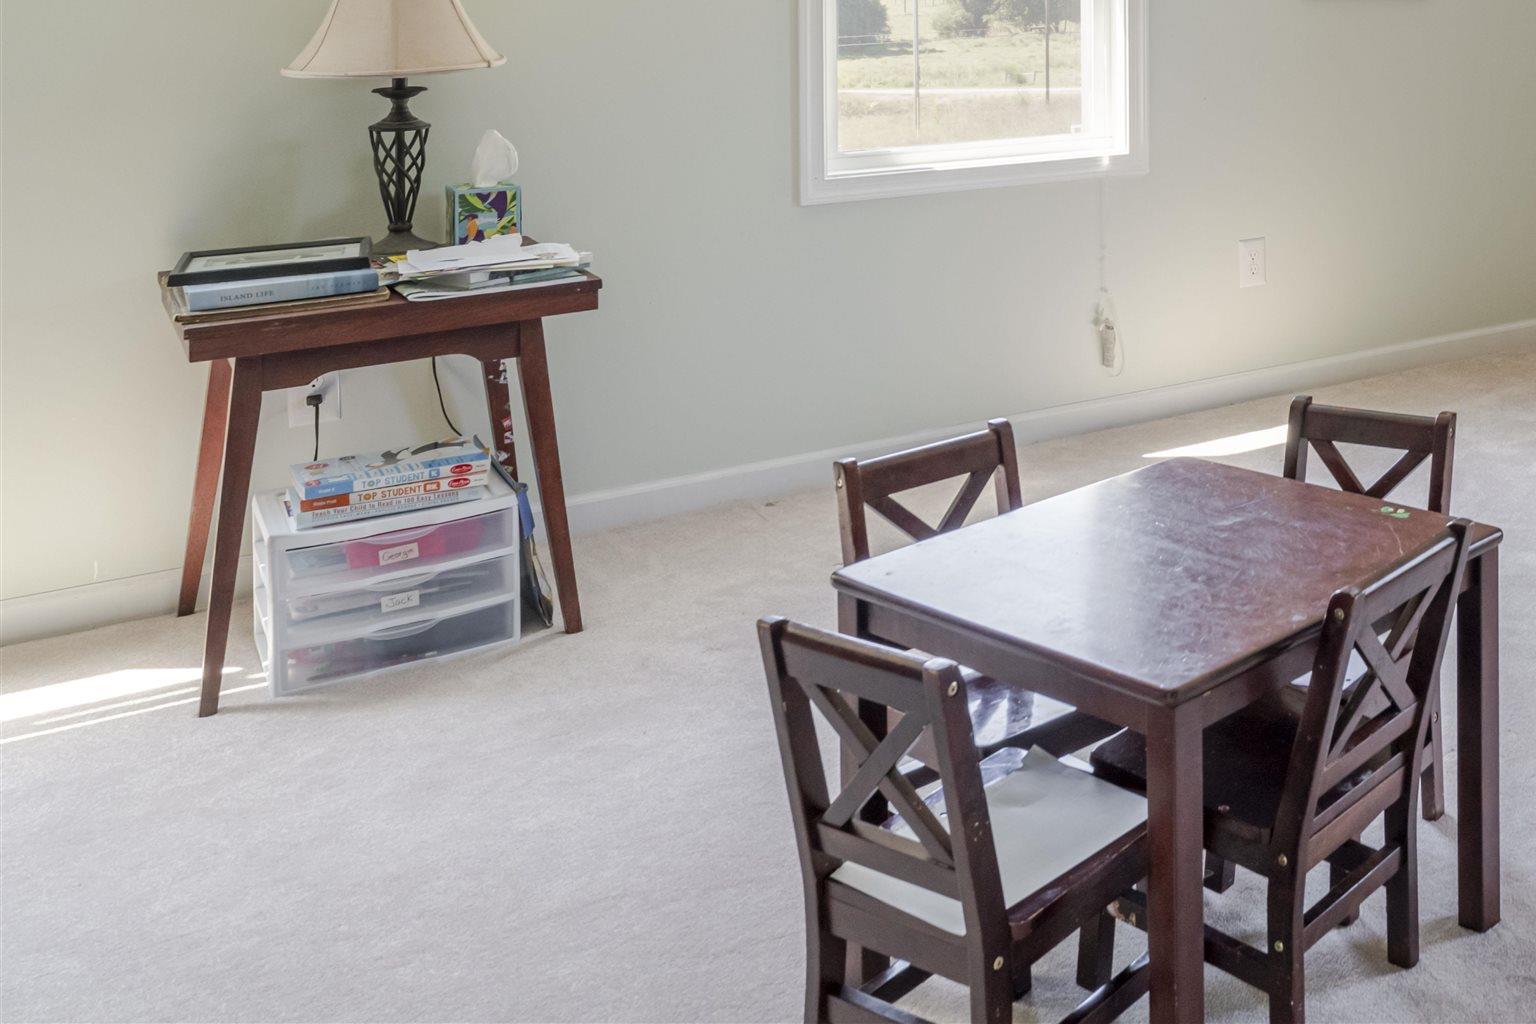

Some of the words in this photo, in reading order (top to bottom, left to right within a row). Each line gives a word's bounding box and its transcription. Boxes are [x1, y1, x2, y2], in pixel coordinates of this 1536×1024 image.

[220, 293, 253, 302] ISLAND
[362, 479, 381, 489] TOP
[385, 471, 424, 486] STUDENT
[358, 492, 377, 502] TOP
[381, 485, 423, 499] STUDENT
[433, 491, 459, 499] Lessons
[385, 593, 413, 608] Jack
